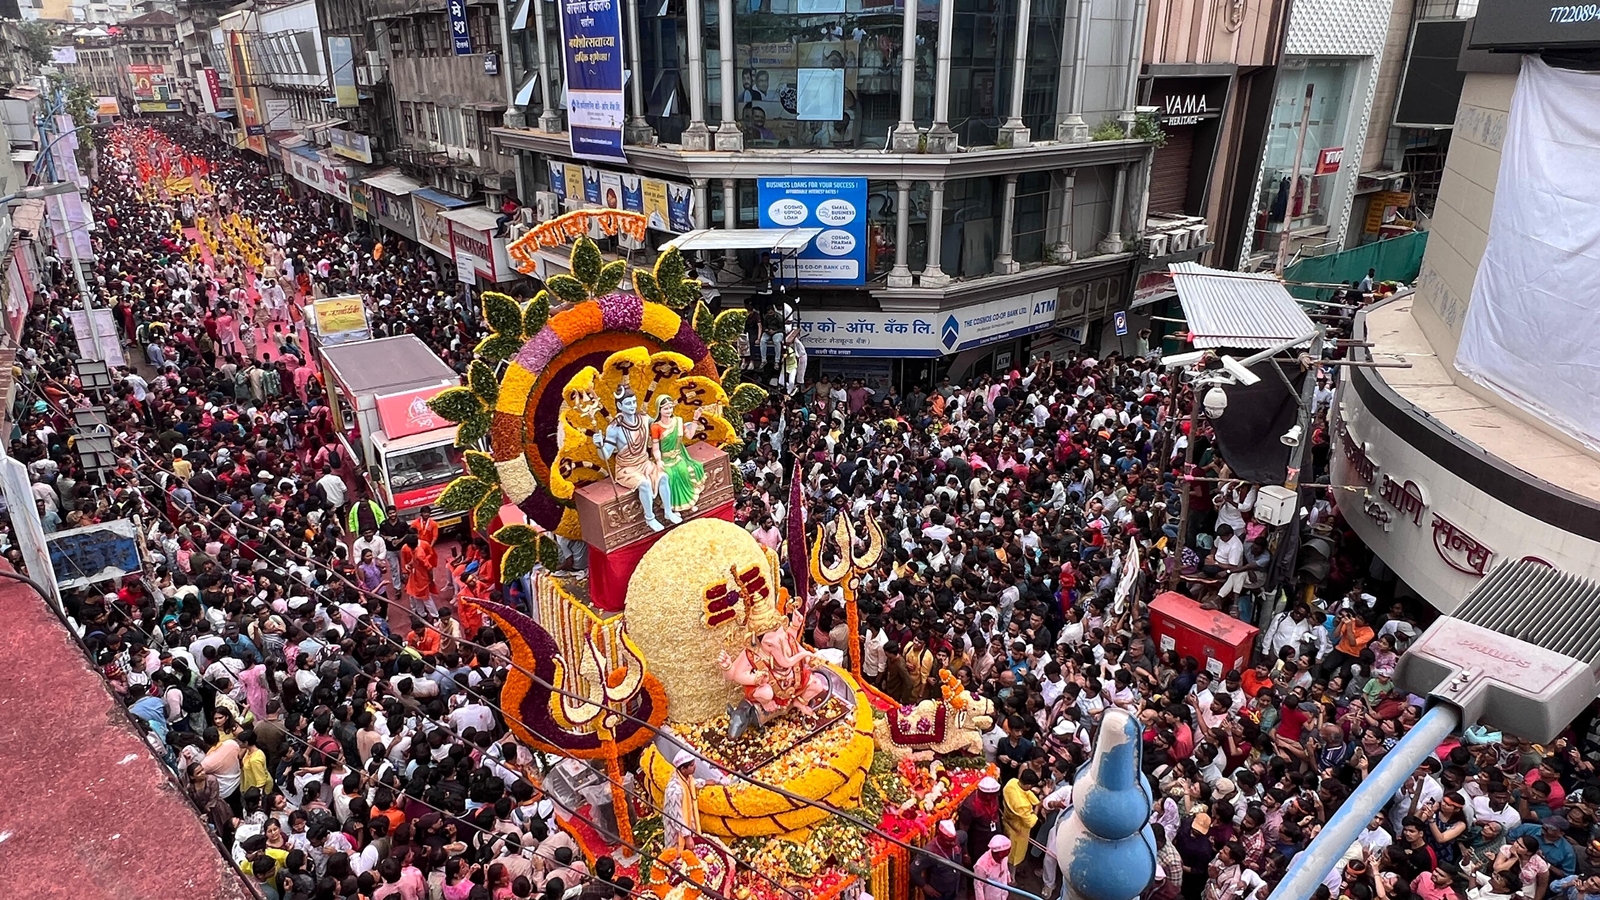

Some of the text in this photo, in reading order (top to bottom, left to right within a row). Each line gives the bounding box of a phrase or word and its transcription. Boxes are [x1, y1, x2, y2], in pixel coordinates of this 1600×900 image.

[1165, 94, 1207, 115] VAMA
[1168, 116, 1198, 126] HERITAGE
[1033, 300, 1056, 315] ATM
[964, 319, 973, 328] THE
[973, 315, 992, 326] COSMOS
[1007, 309, 1018, 318] BANK
[1019, 307, 1027, 315] LTD.
[912, 319, 935, 334] लि.
[1058, 327, 1080, 339] ATM
[997, 356, 1010, 365] ATM
[1378, 473, 1429, 527] आणि
[1431, 511, 1498, 578] सन्स
